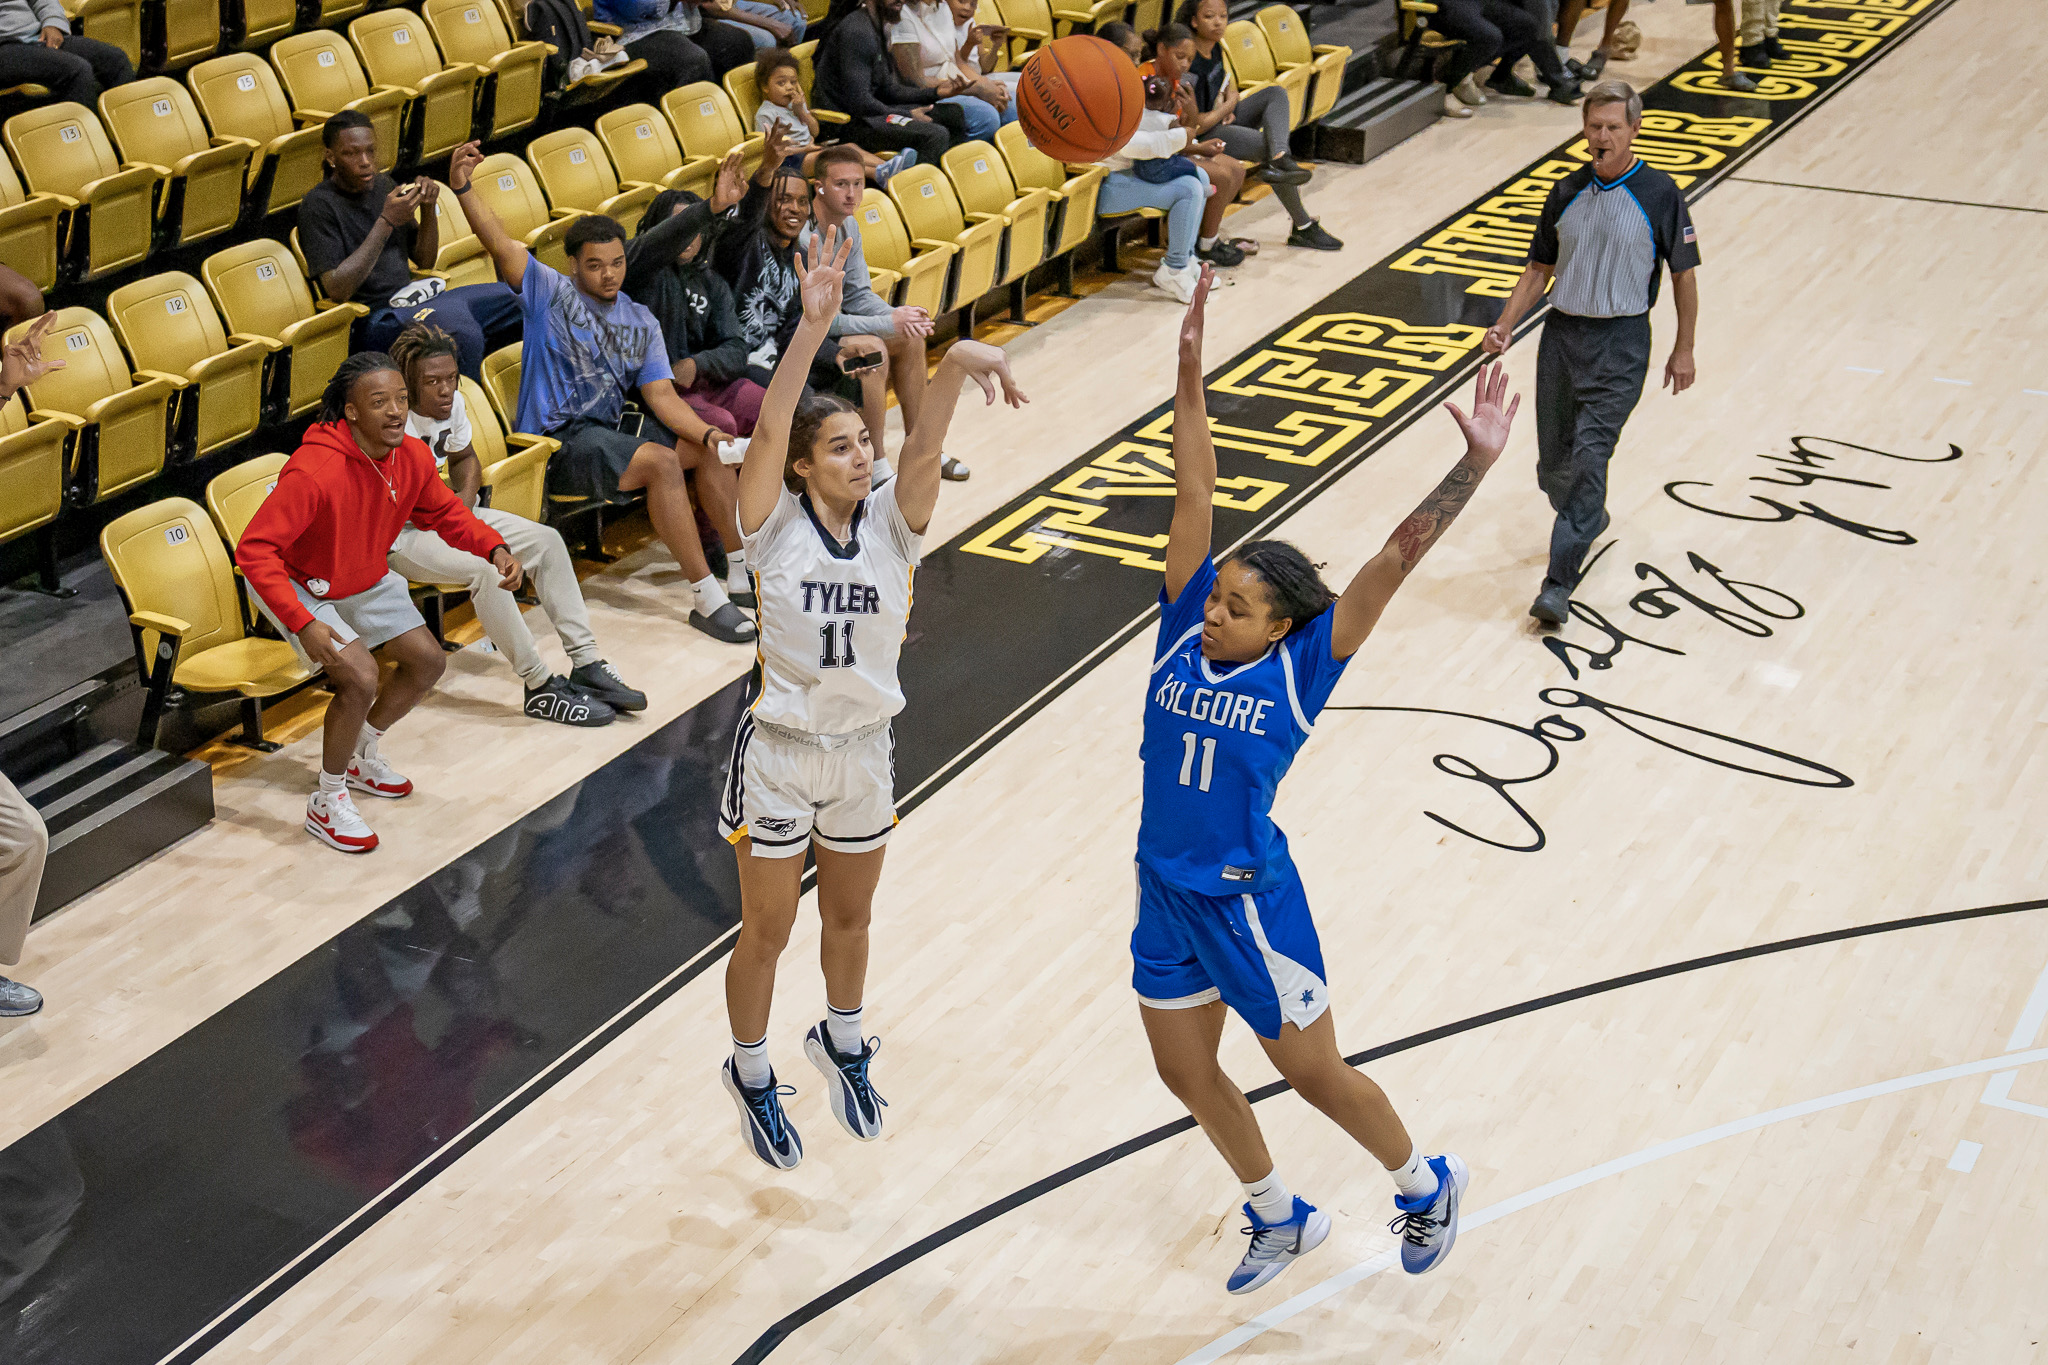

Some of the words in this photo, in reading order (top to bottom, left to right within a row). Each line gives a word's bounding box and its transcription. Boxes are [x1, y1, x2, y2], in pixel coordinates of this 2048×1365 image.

[1026, 57, 1076, 132] SPALDING
[63, 128, 77, 139] 13
[260, 266, 273, 277] 13
[169, 300, 183, 311] 12
[70, 335, 84, 348] 11
[959, 312, 1487, 571] TYLER
[169, 528, 184, 542] 10
[800, 580, 880, 614] TYLER
[820, 619, 857, 668] 11
[526, 693, 590, 722] AIR
[1155, 672, 1275, 736] KILGORE
[1178, 731, 1217, 792] 11
